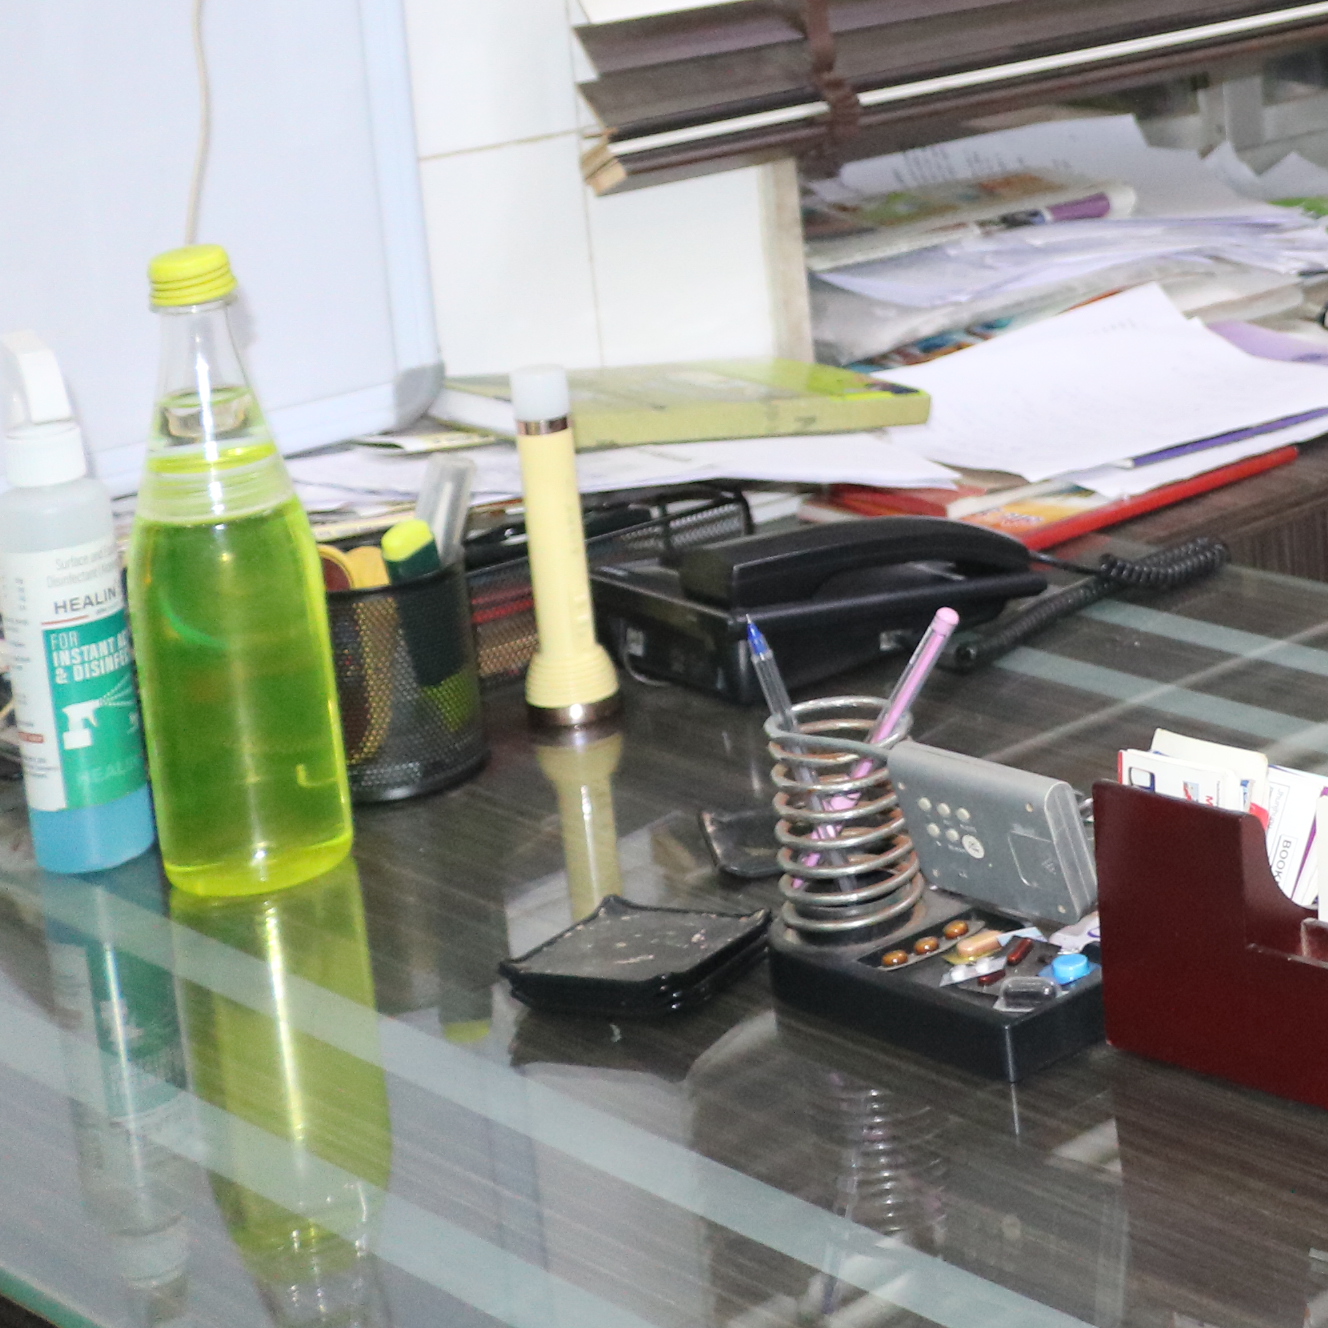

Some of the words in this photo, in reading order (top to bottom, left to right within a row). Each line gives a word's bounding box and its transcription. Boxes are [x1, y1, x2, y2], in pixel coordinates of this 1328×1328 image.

[50, 630, 79, 651] FOR
[53, 635, 117, 667] INSTANT
[55, 667, 69, 684] &
